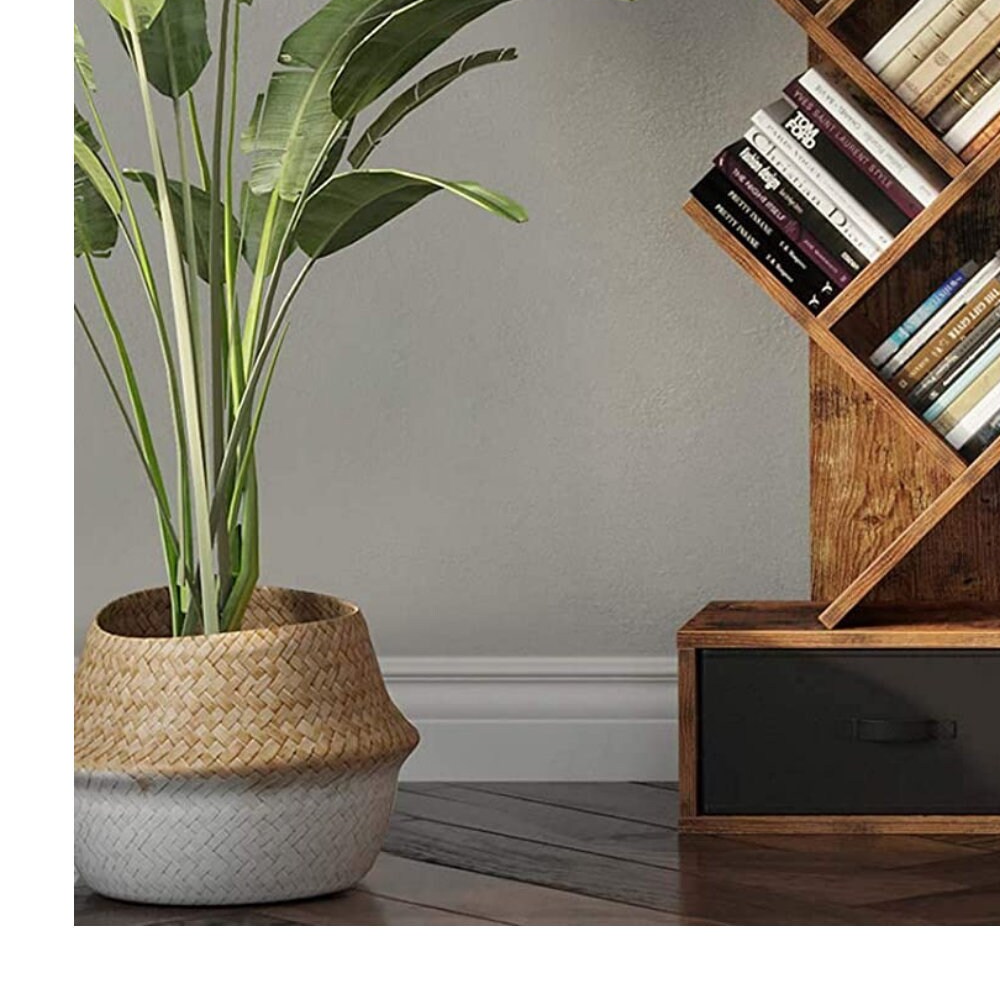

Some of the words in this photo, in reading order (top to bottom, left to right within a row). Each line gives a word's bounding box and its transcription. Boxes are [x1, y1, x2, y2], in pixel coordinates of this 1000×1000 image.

[783, 118, 817, 151] FORD
[789, 109, 821, 139] TOM
[791, 89, 815, 111] YVES
[811, 108, 836, 133] SAINT
[832, 130, 871, 167] LAURENT
[867, 164, 893, 189] STYLE
[747, 129, 828, 207] Christian
[826, 206, 870, 248] Dior
